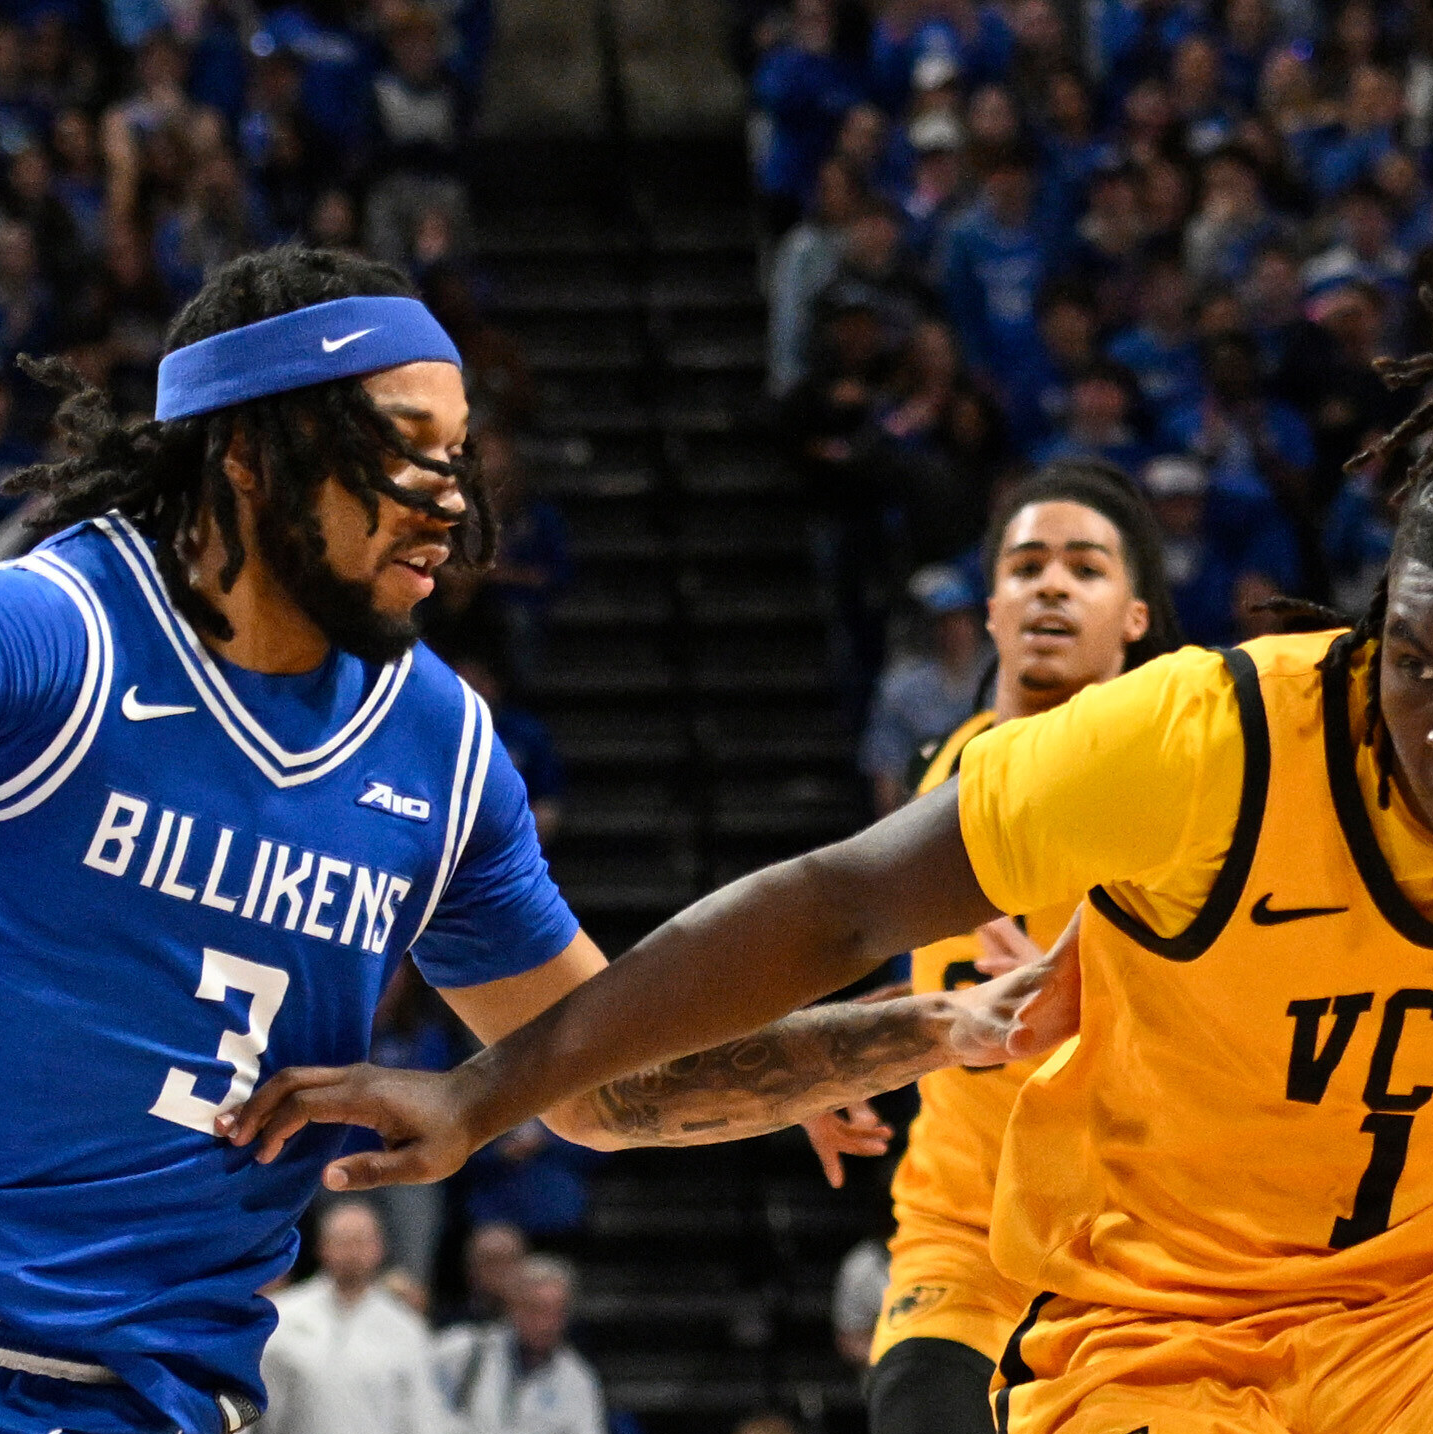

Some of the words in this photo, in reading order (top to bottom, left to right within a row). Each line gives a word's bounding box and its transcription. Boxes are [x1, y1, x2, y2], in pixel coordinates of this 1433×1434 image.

[83, 792, 411, 954] BILLIKENS
[358, 782, 430, 818] A10
[148, 947, 289, 1136] 3
[1329, 1113, 1414, 1249] 1
